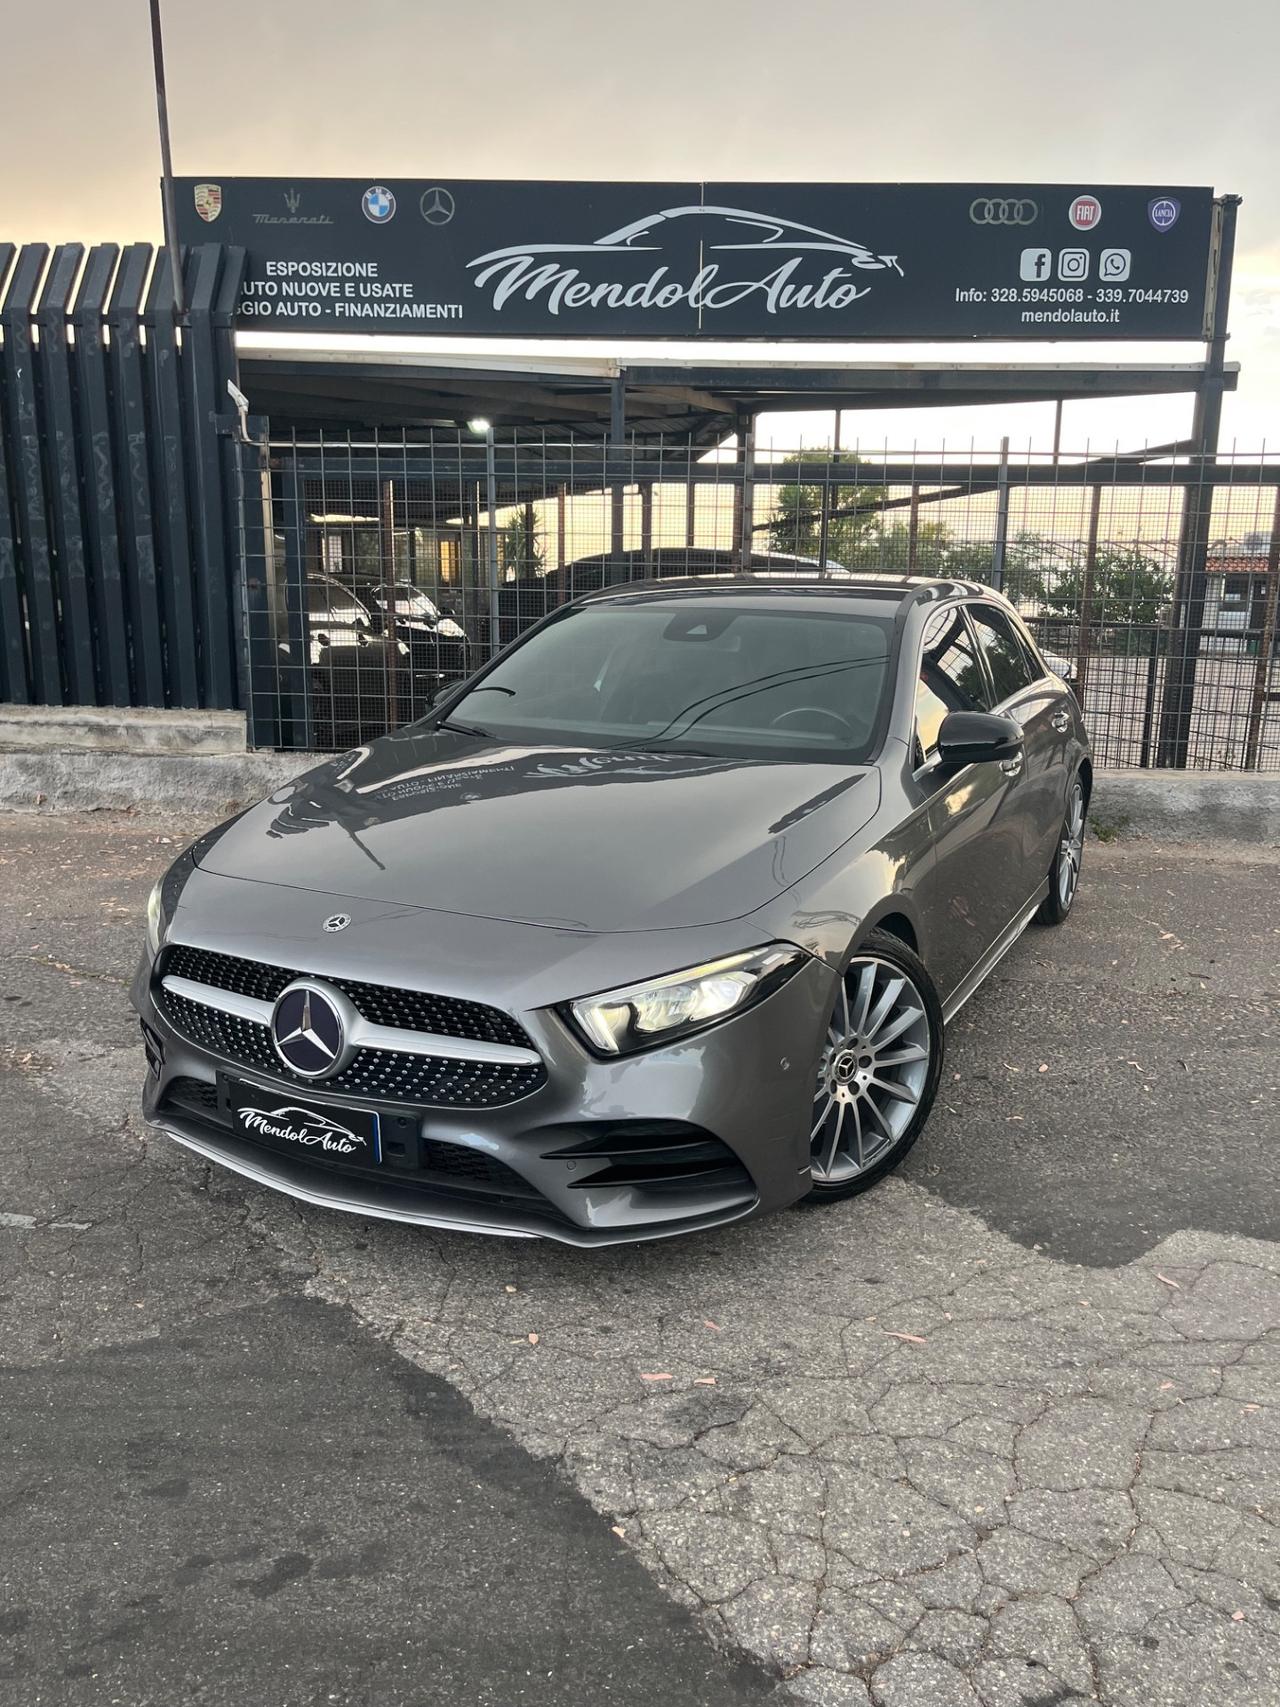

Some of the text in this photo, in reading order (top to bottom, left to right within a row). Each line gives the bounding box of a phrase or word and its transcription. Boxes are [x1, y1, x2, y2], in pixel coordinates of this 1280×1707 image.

[1076, 205, 1095, 221] FIAT
[265, 261, 379, 278] ESPOSIZIONE
[241, 281, 414, 298] UTO NUOVE E USATE
[955, 287, 988, 303] Info:
[990, 287, 1084, 303] 328.5945068
[1096, 288, 1189, 304] 339.7044739
[275, 301, 322, 317] AUTO
[334, 302, 463, 319] FINANZIAMENTI
[1021, 308, 1121, 323] mendolauto.it
